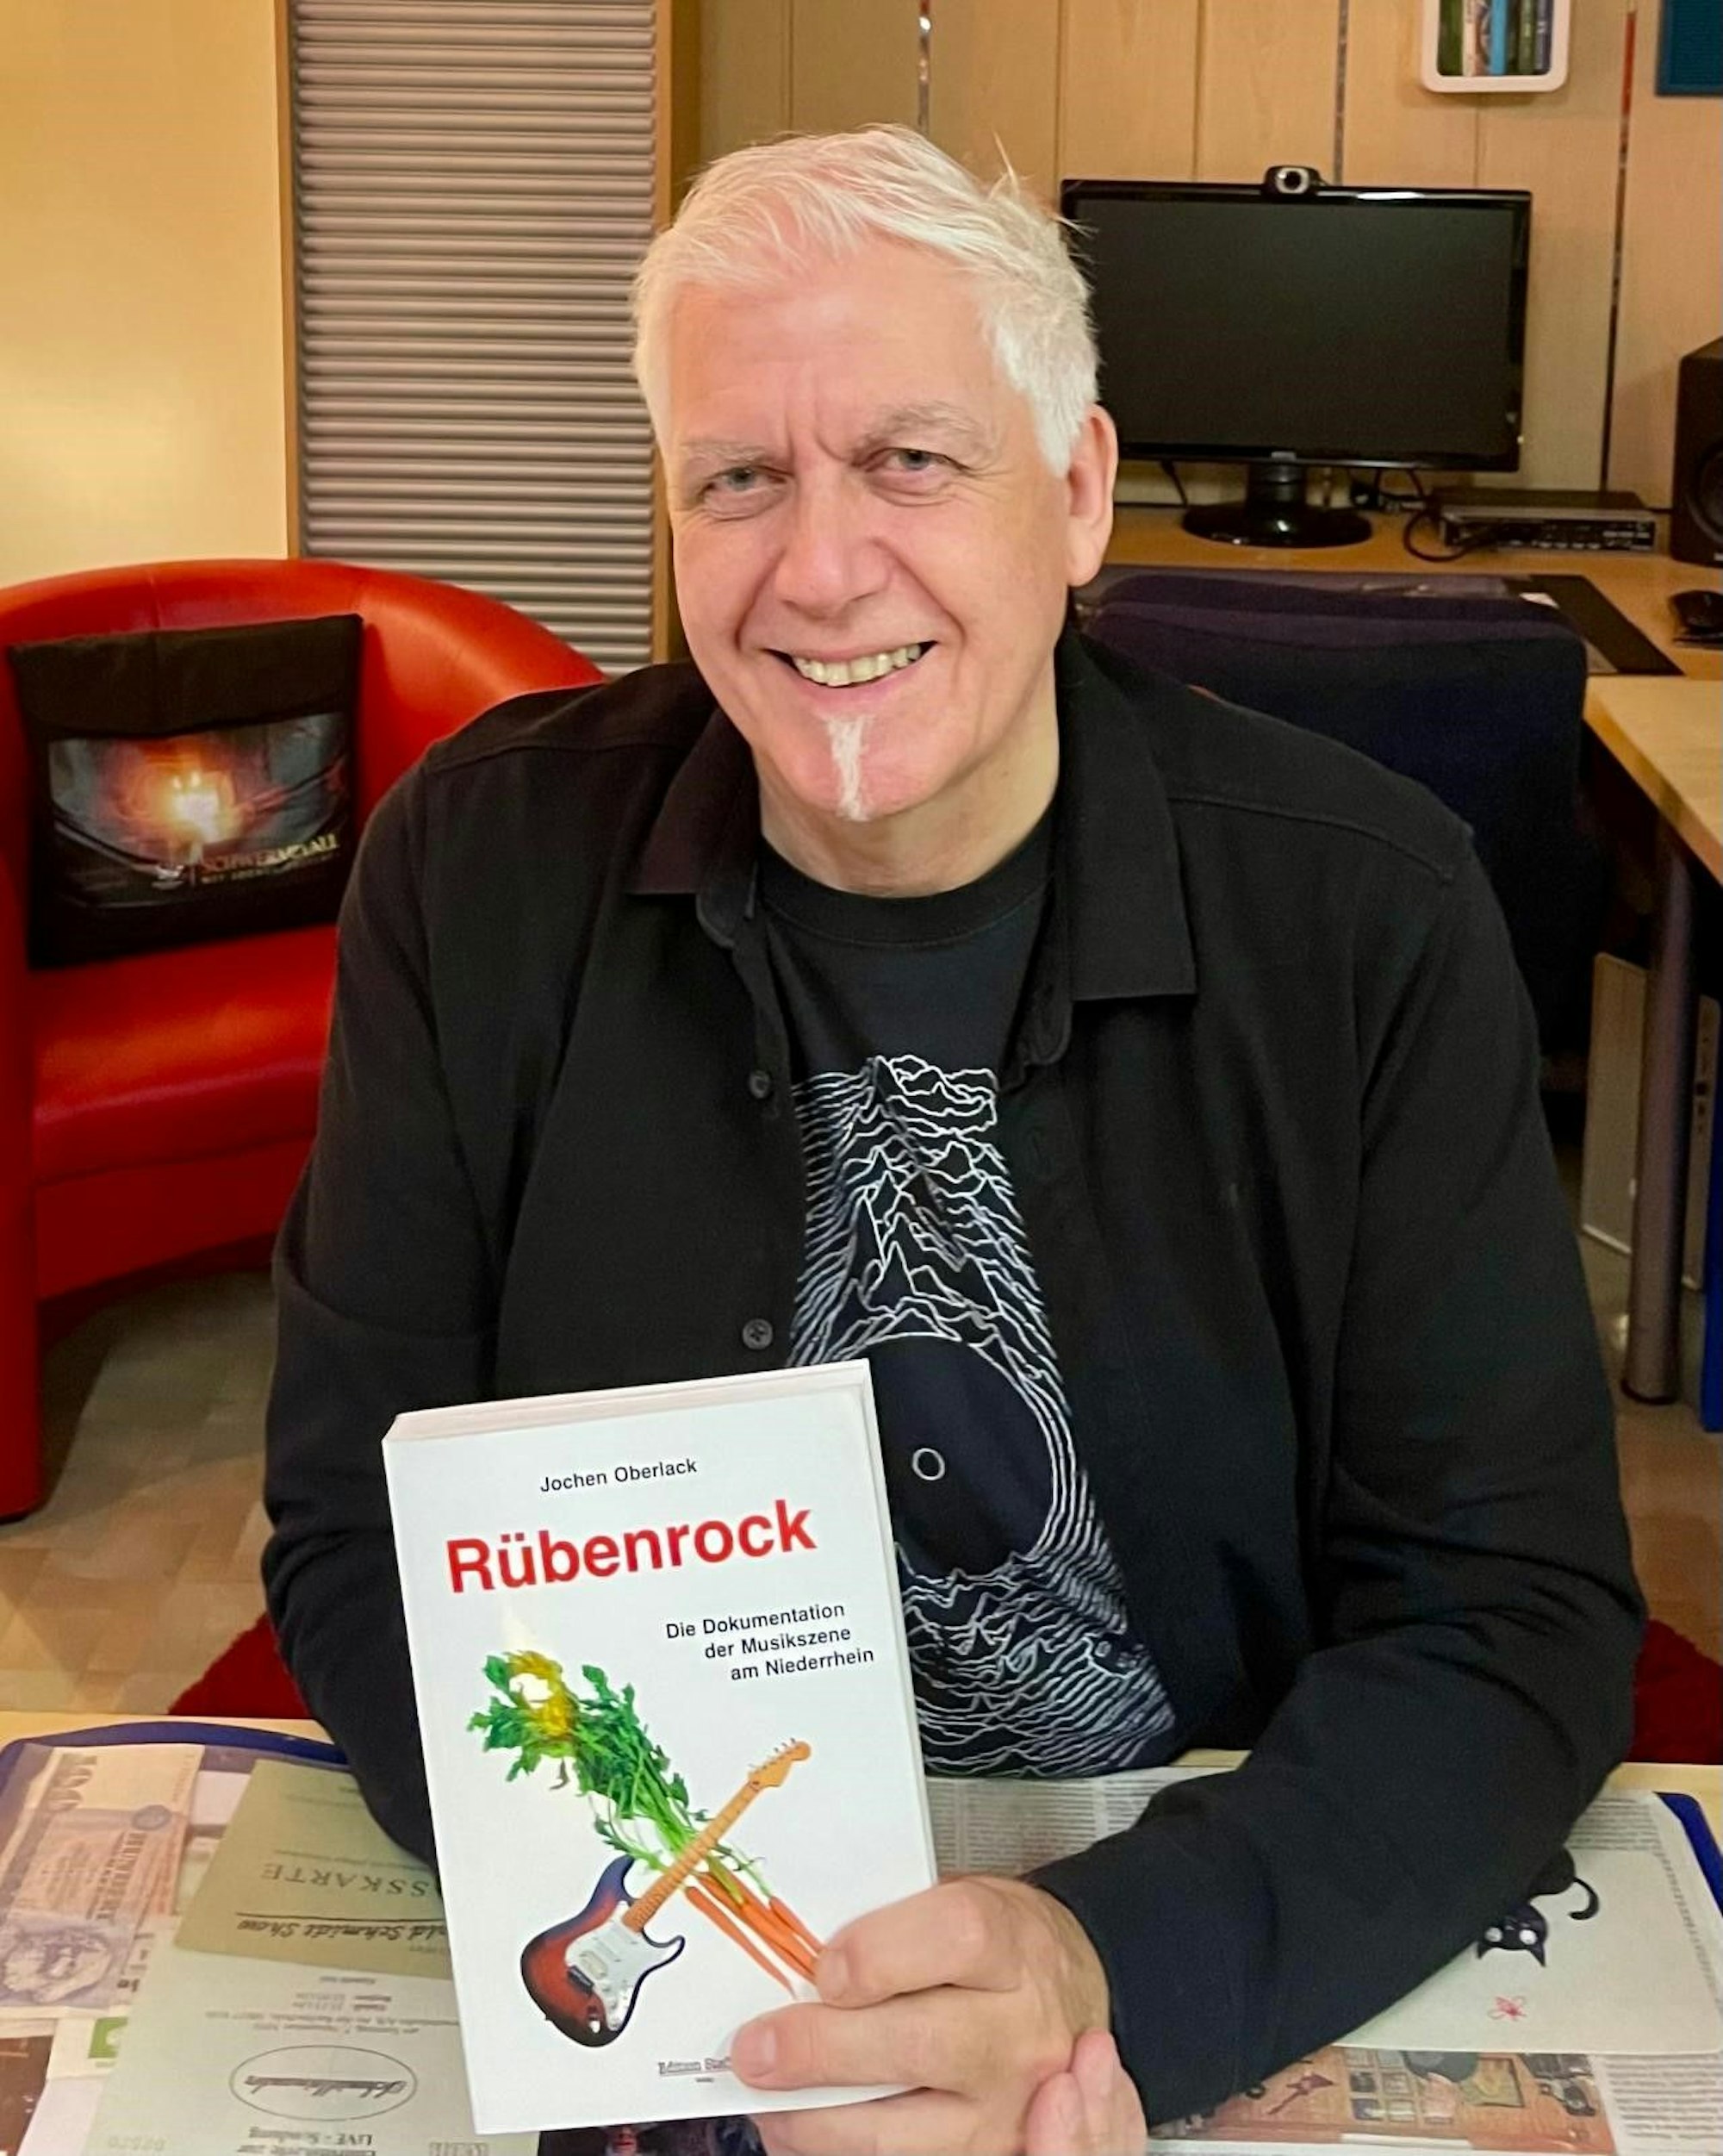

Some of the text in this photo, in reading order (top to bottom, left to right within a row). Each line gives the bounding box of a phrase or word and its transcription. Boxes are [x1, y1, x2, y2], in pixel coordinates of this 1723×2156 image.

[540, 1458, 697, 1492] Jochen Oberlack
[447, 1499, 817, 1593] Rübenrock
[666, 1605, 844, 1639] Die Dokumentation
[705, 1629, 850, 1659] der Musikszene
[731, 1651, 874, 1681] am Niederrhein
[237, 1919, 301, 1938] Show
[304, 1922, 405, 1941] Schmidt
